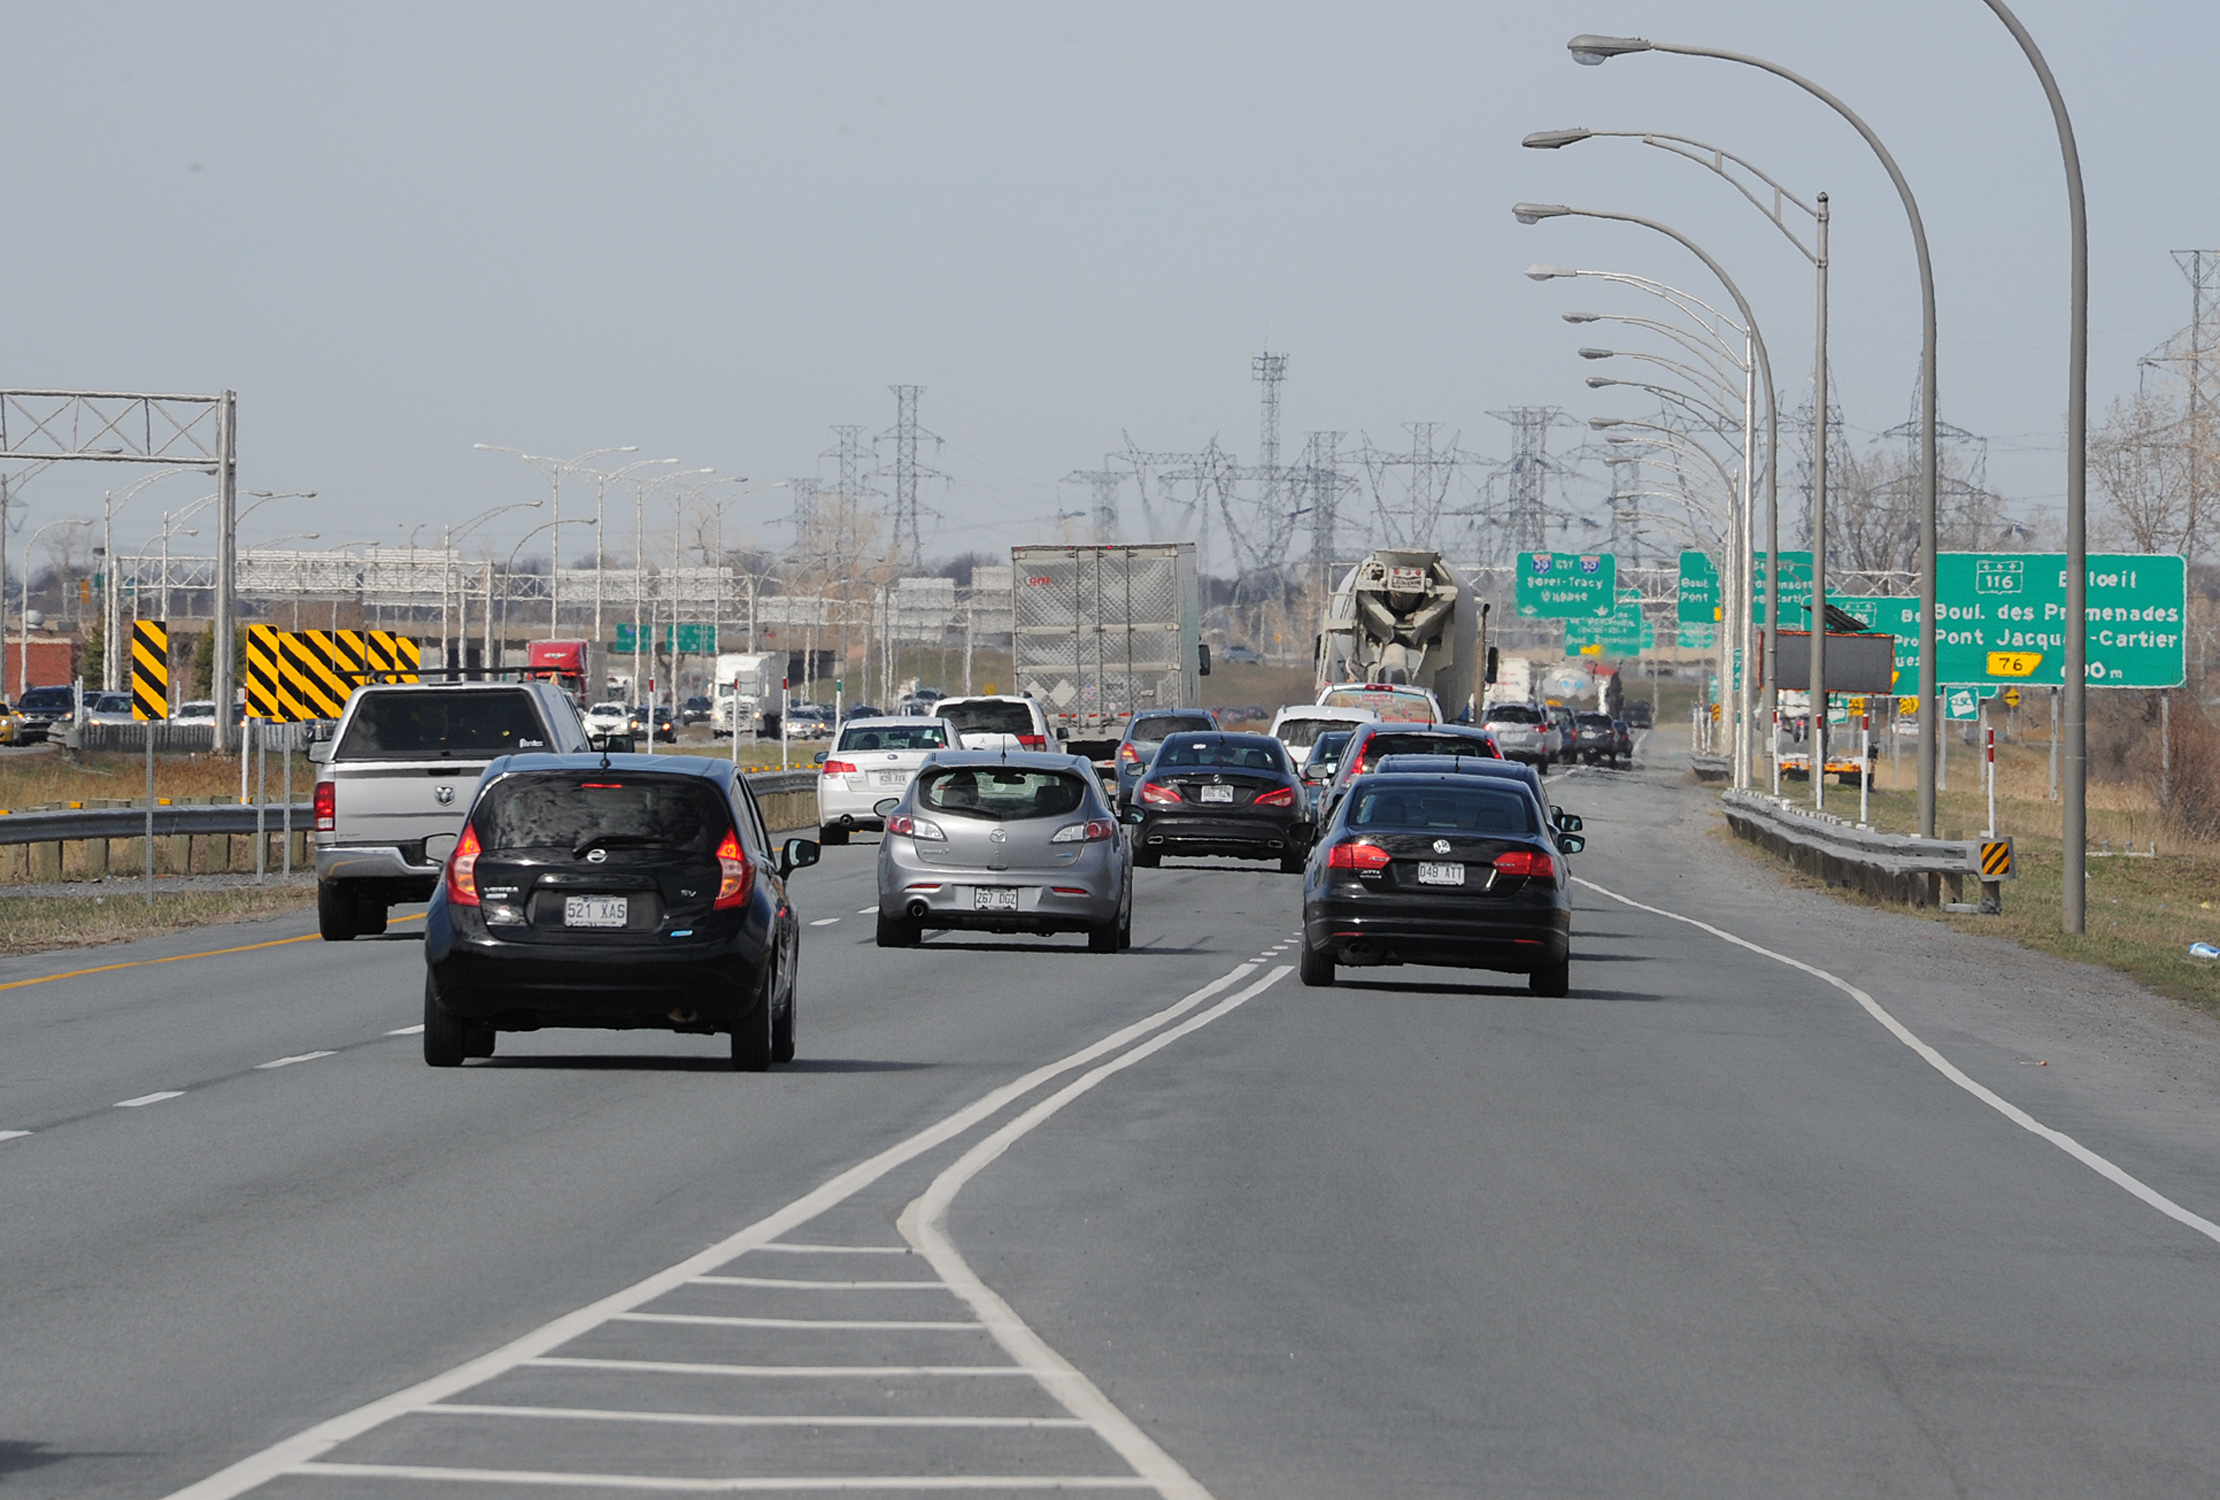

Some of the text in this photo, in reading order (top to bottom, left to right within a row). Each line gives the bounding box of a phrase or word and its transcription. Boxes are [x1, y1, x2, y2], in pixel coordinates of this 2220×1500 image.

[1986, 575, 2014, 588] 116
[1936, 603, 1986, 620] Boul.
[1997, 604, 2035, 620] des
[2044, 603, 2179, 622] Prmenades
[1936, 628, 1984, 645] Pont
[1996, 628, 2177, 650] Jacqu-Cartier
[1999, 657, 2023, 671] 76
[1444, 866, 1463, 879] ATT
[567, 902, 626, 919] 521 XAS
